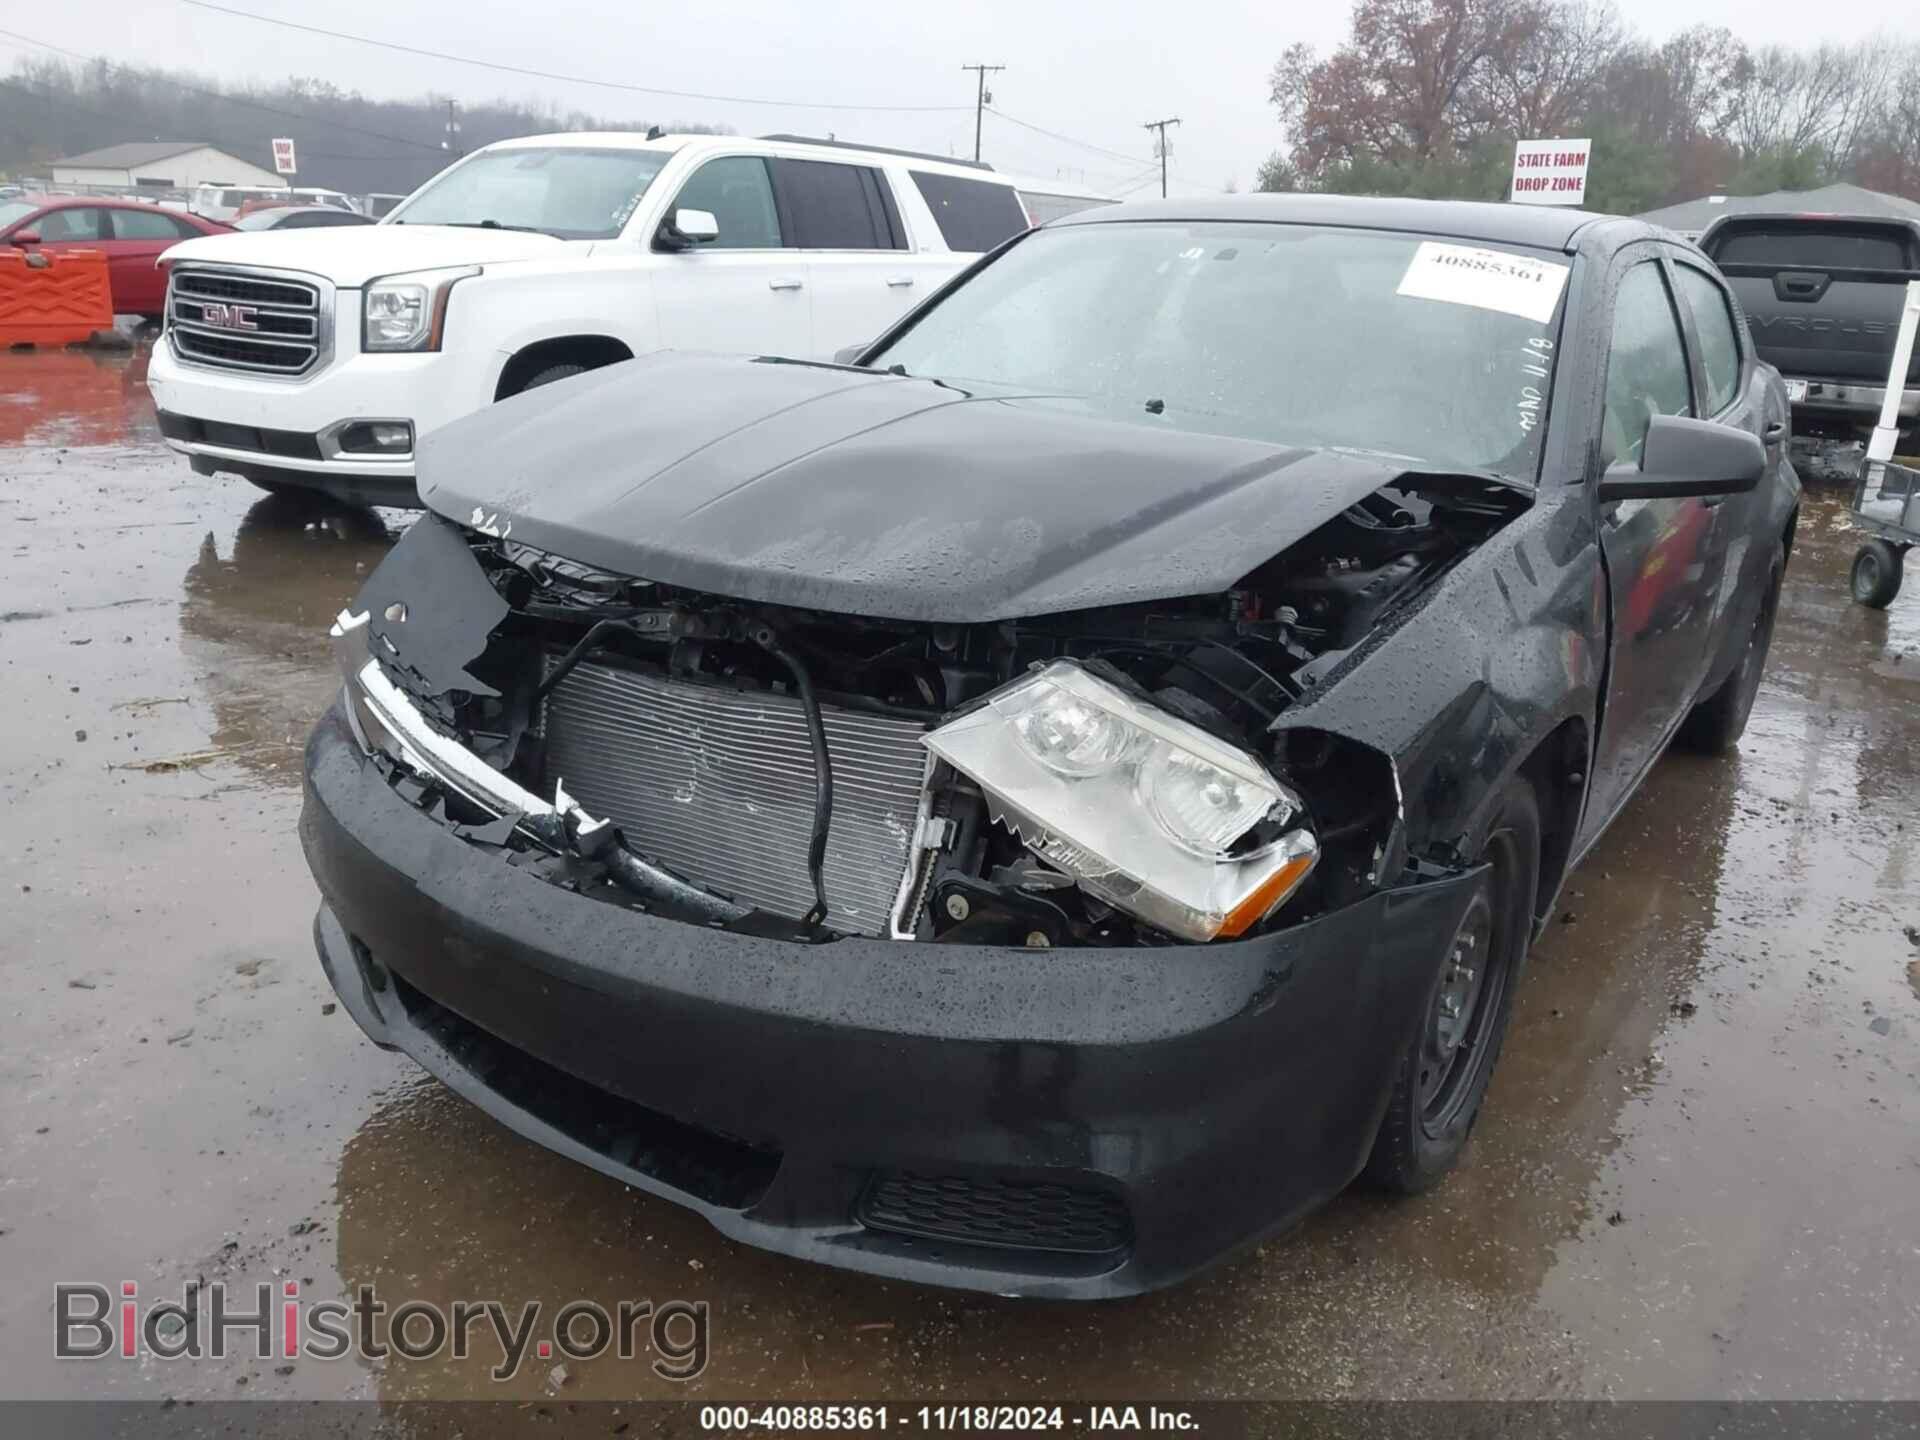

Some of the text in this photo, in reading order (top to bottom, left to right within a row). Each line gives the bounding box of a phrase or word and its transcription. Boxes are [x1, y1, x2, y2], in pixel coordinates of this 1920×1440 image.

[1518, 152, 1586, 168] STATE FARM
[1515, 176, 1583, 191] DROP ZONE
[1432, 254, 1545, 283] 40885361
[202, 302, 259, 330] GMC
